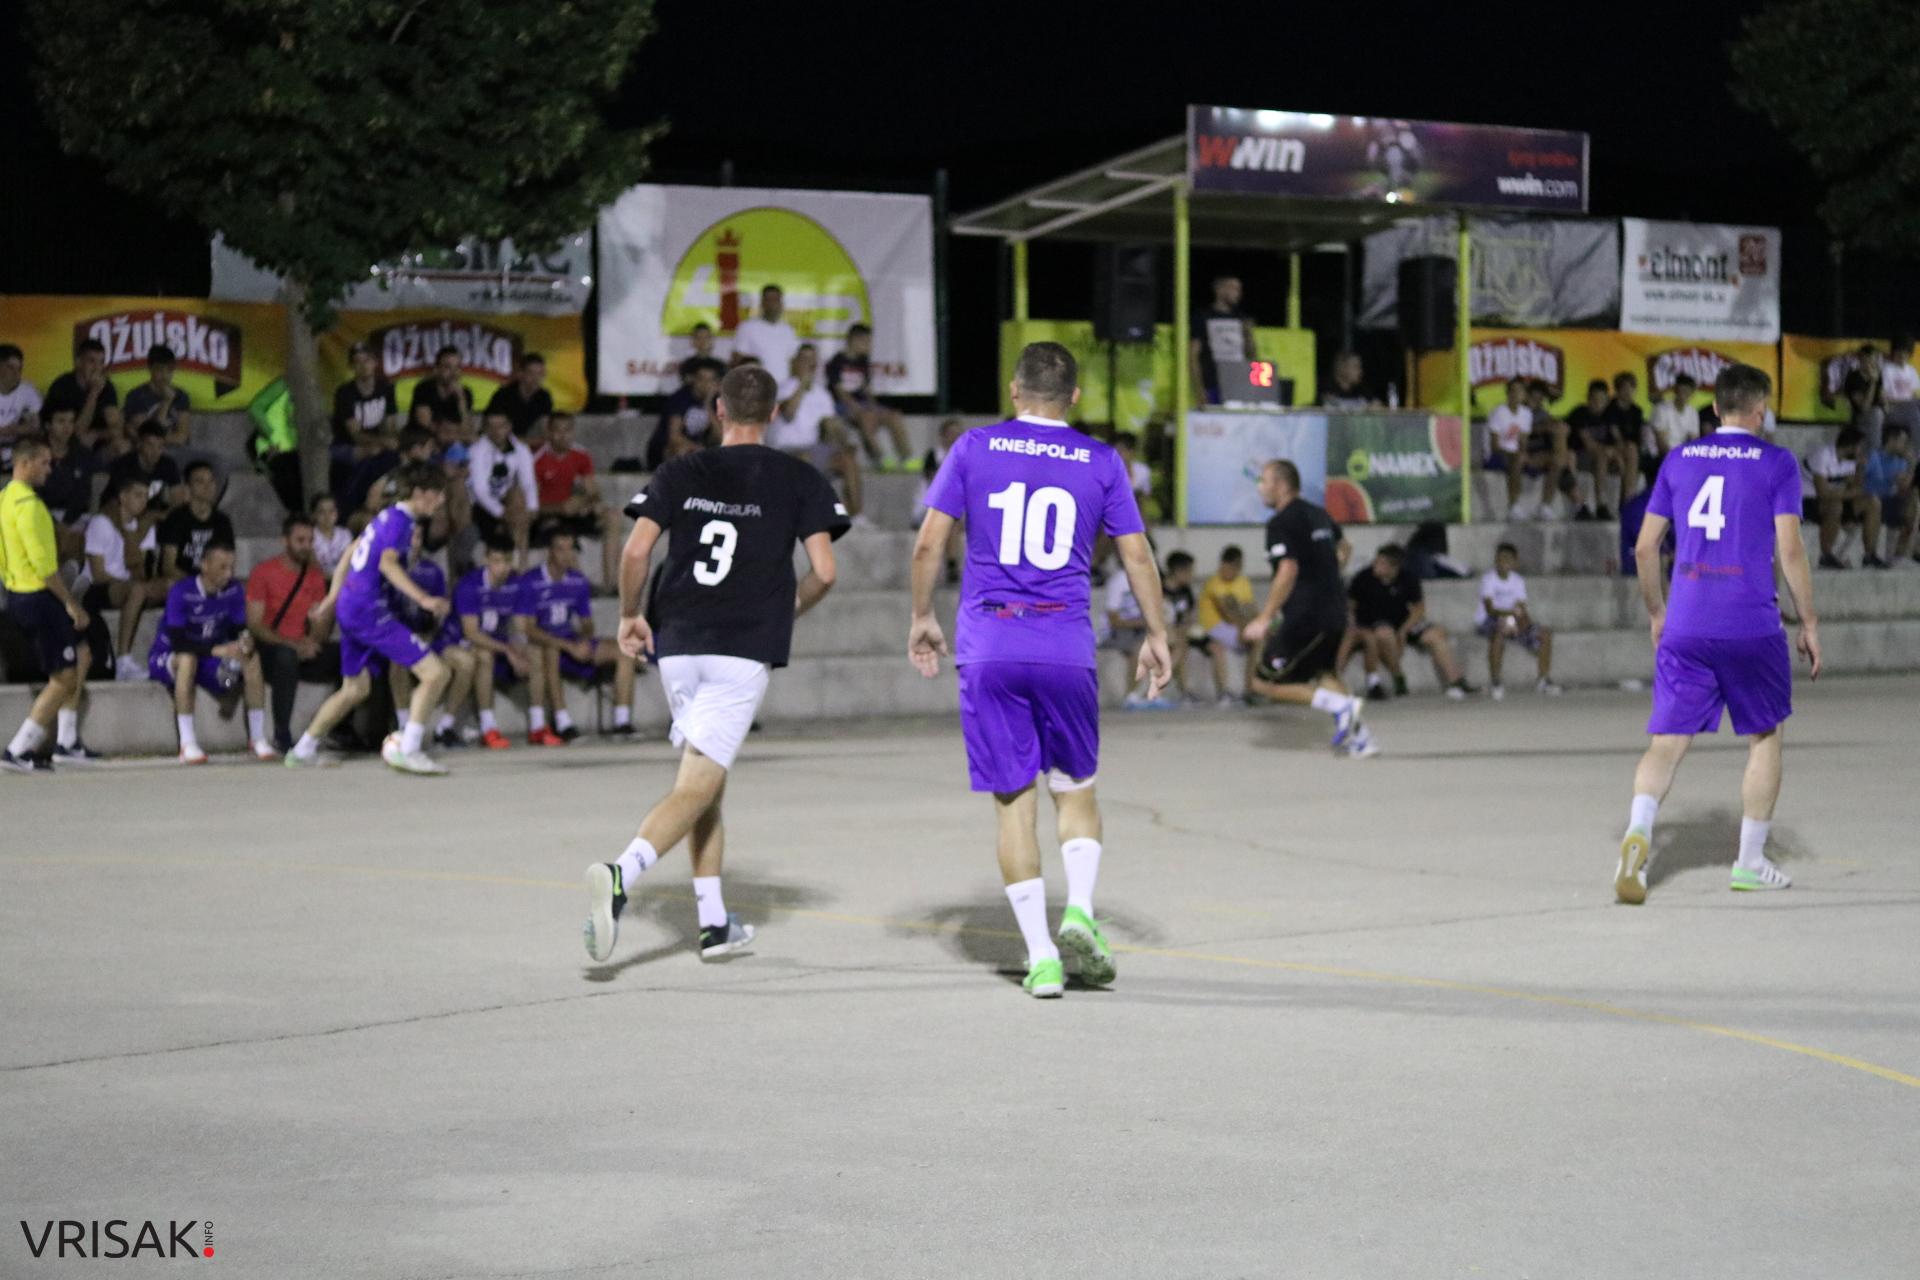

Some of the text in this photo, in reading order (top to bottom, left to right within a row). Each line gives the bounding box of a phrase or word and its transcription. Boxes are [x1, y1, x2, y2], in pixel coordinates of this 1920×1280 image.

[988, 436, 1090, 464] KNEŠPOLJE
[1682, 444, 1762, 461] KNEŠPOLJE
[987, 481, 1077, 571] 10
[1687, 475, 1726, 541] 4
[692, 519, 739, 587] 3
